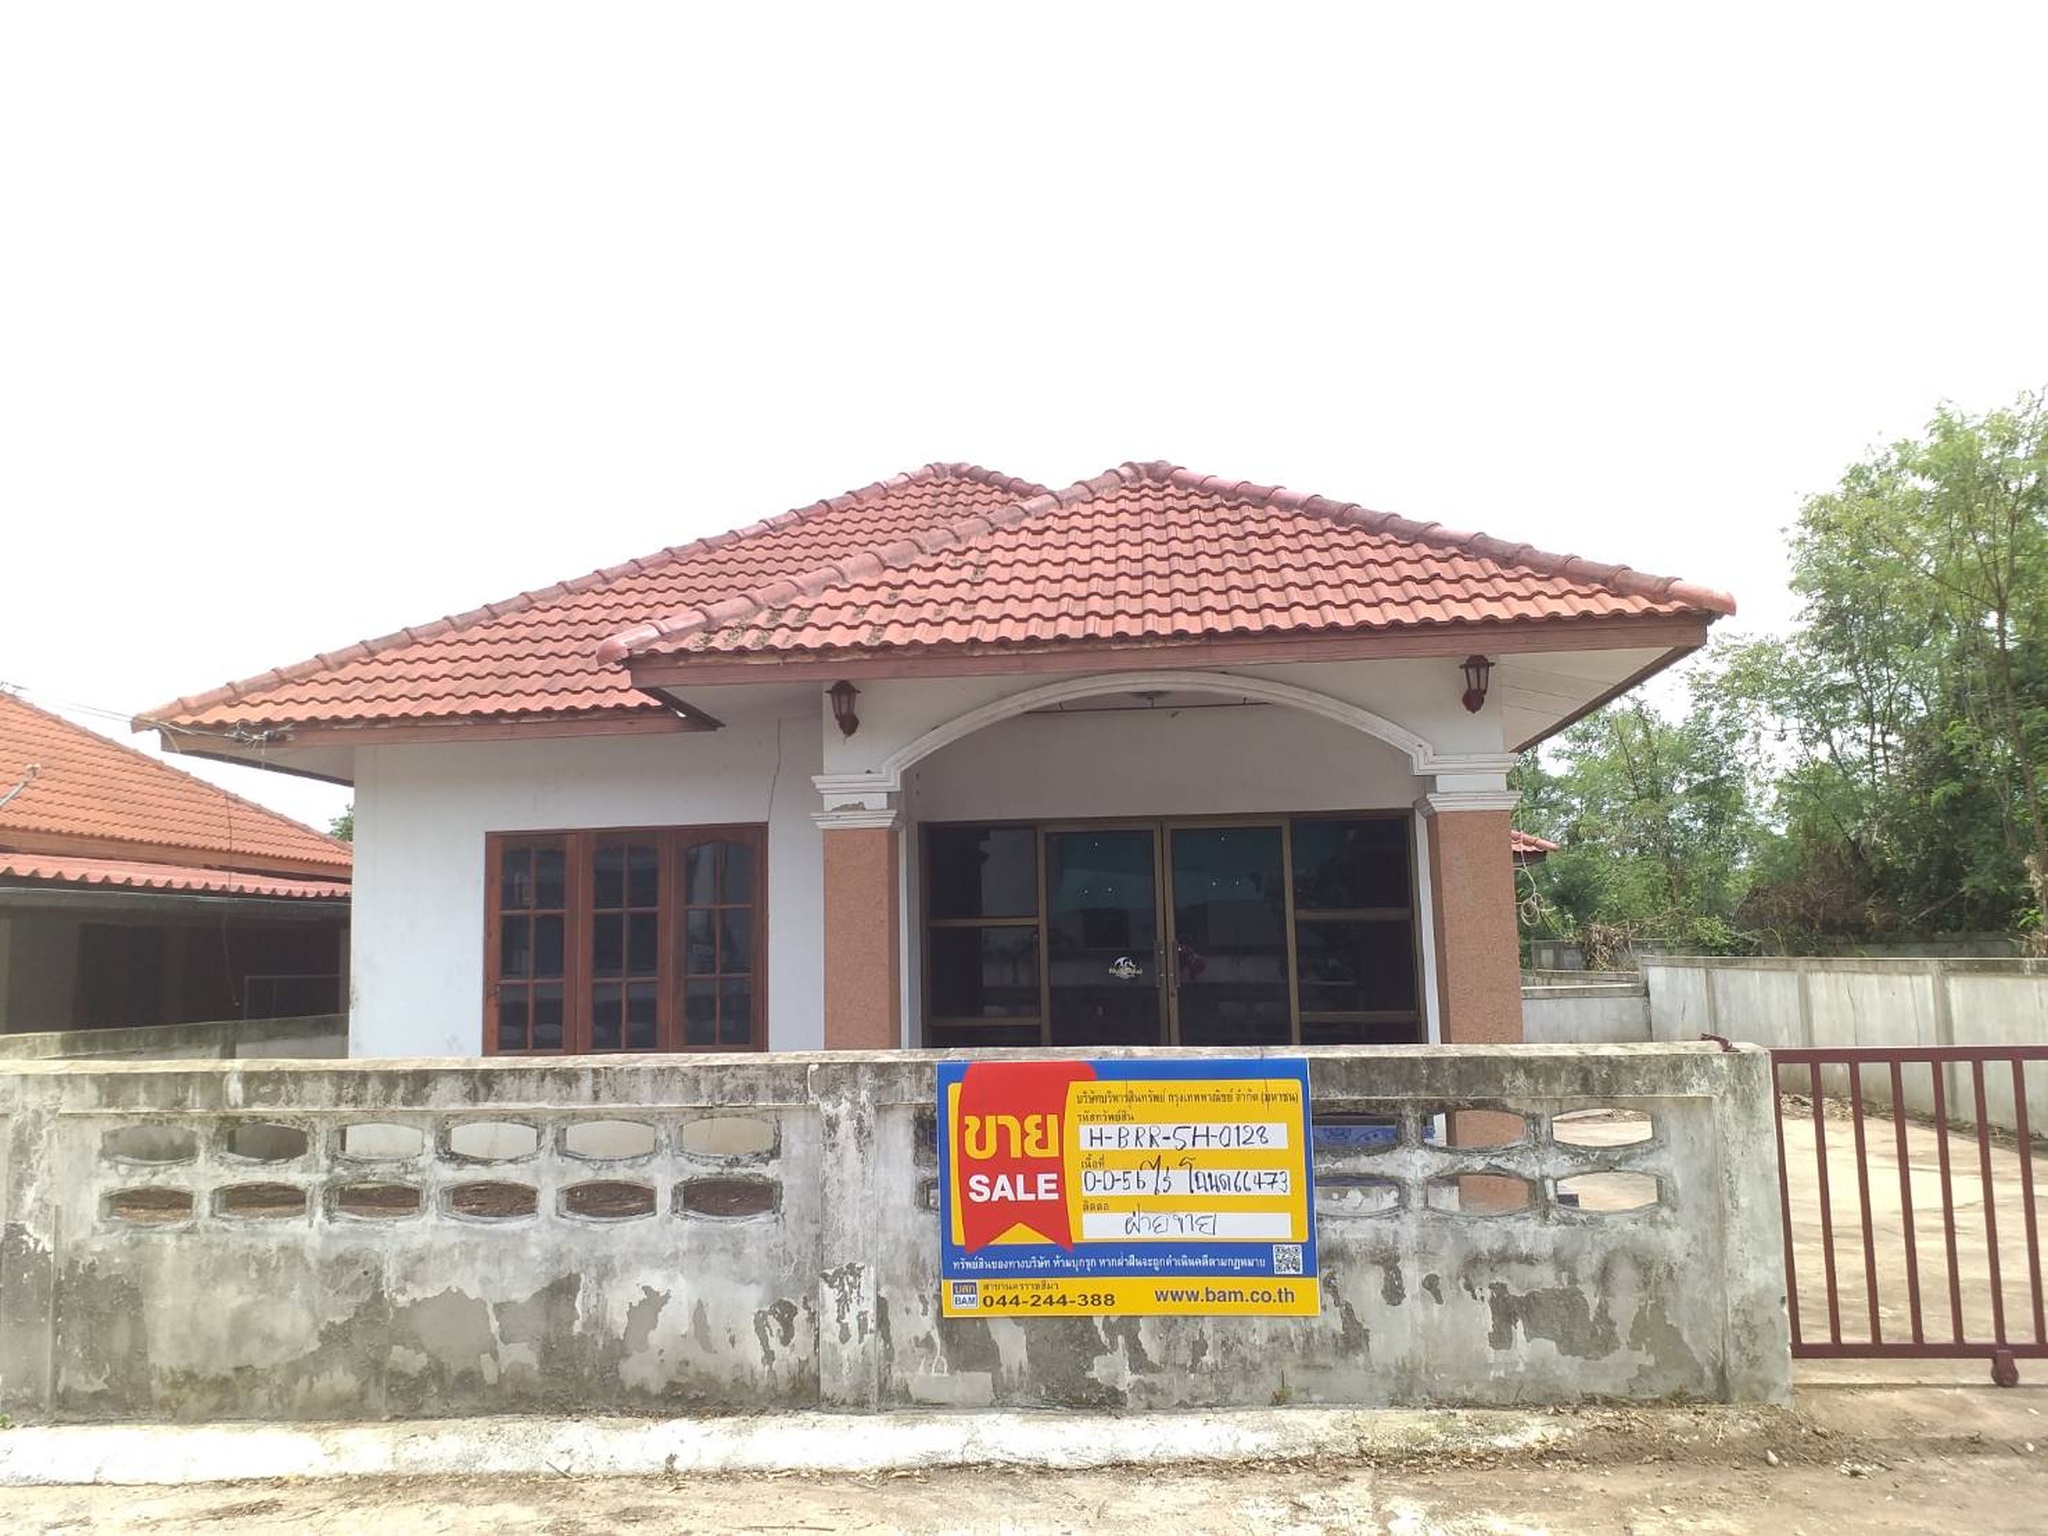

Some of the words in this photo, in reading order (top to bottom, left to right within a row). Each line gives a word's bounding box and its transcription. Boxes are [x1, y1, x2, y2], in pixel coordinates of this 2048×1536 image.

[964, 1114, 1059, 1160] ขาย
[968, 1173, 1059, 1203] SALE
[954, 1296, 977, 1306] BAM
[983, 1293, 1116, 1308] 044-244-388
[1155, 1287, 1295, 1304] www.bam.co.th
